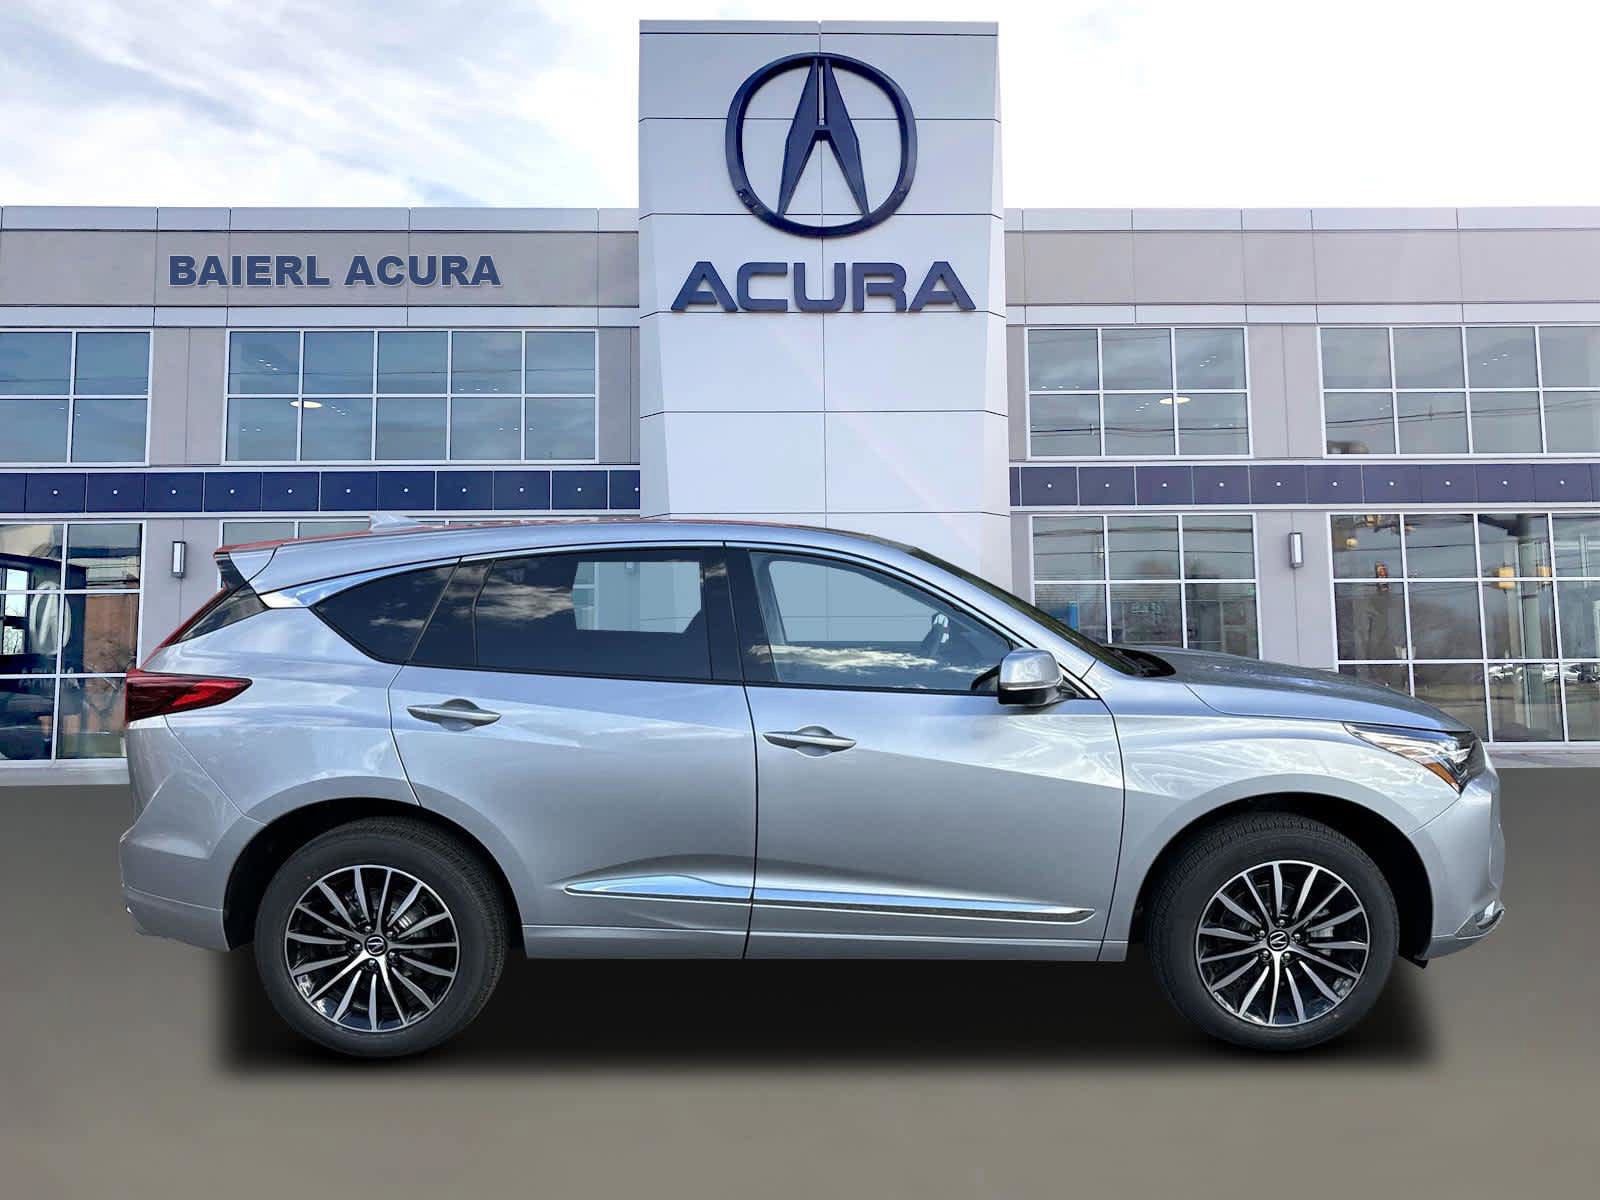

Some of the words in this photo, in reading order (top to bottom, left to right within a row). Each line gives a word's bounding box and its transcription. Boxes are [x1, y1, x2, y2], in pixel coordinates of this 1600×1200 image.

[168, 255, 331, 287] BAIERL
[343, 255, 503, 287] ACURA
[670, 260, 977, 313] ACURA
